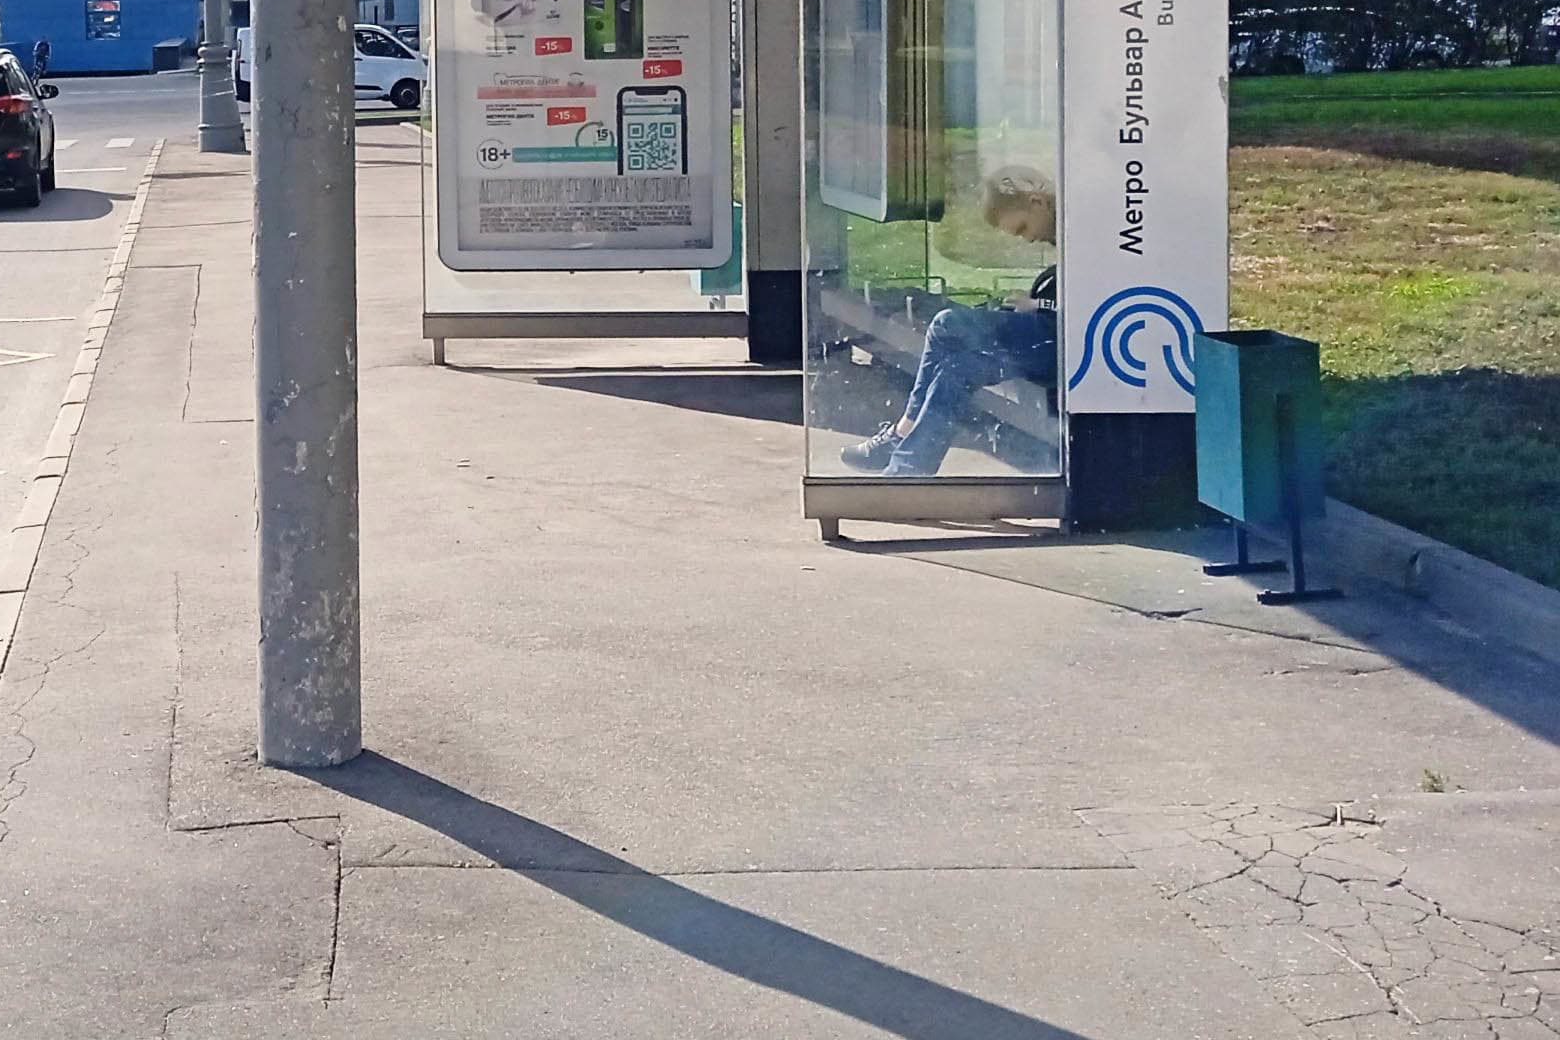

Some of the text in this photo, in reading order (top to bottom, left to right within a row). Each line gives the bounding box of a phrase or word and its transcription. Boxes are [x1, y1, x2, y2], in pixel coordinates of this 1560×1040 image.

[1119, 27, 1149, 144] Бульвар
[480, 147, 511, 162] 18+
[596, 128, 609, 138] 15
[1119, 160, 1149, 255] Метро
